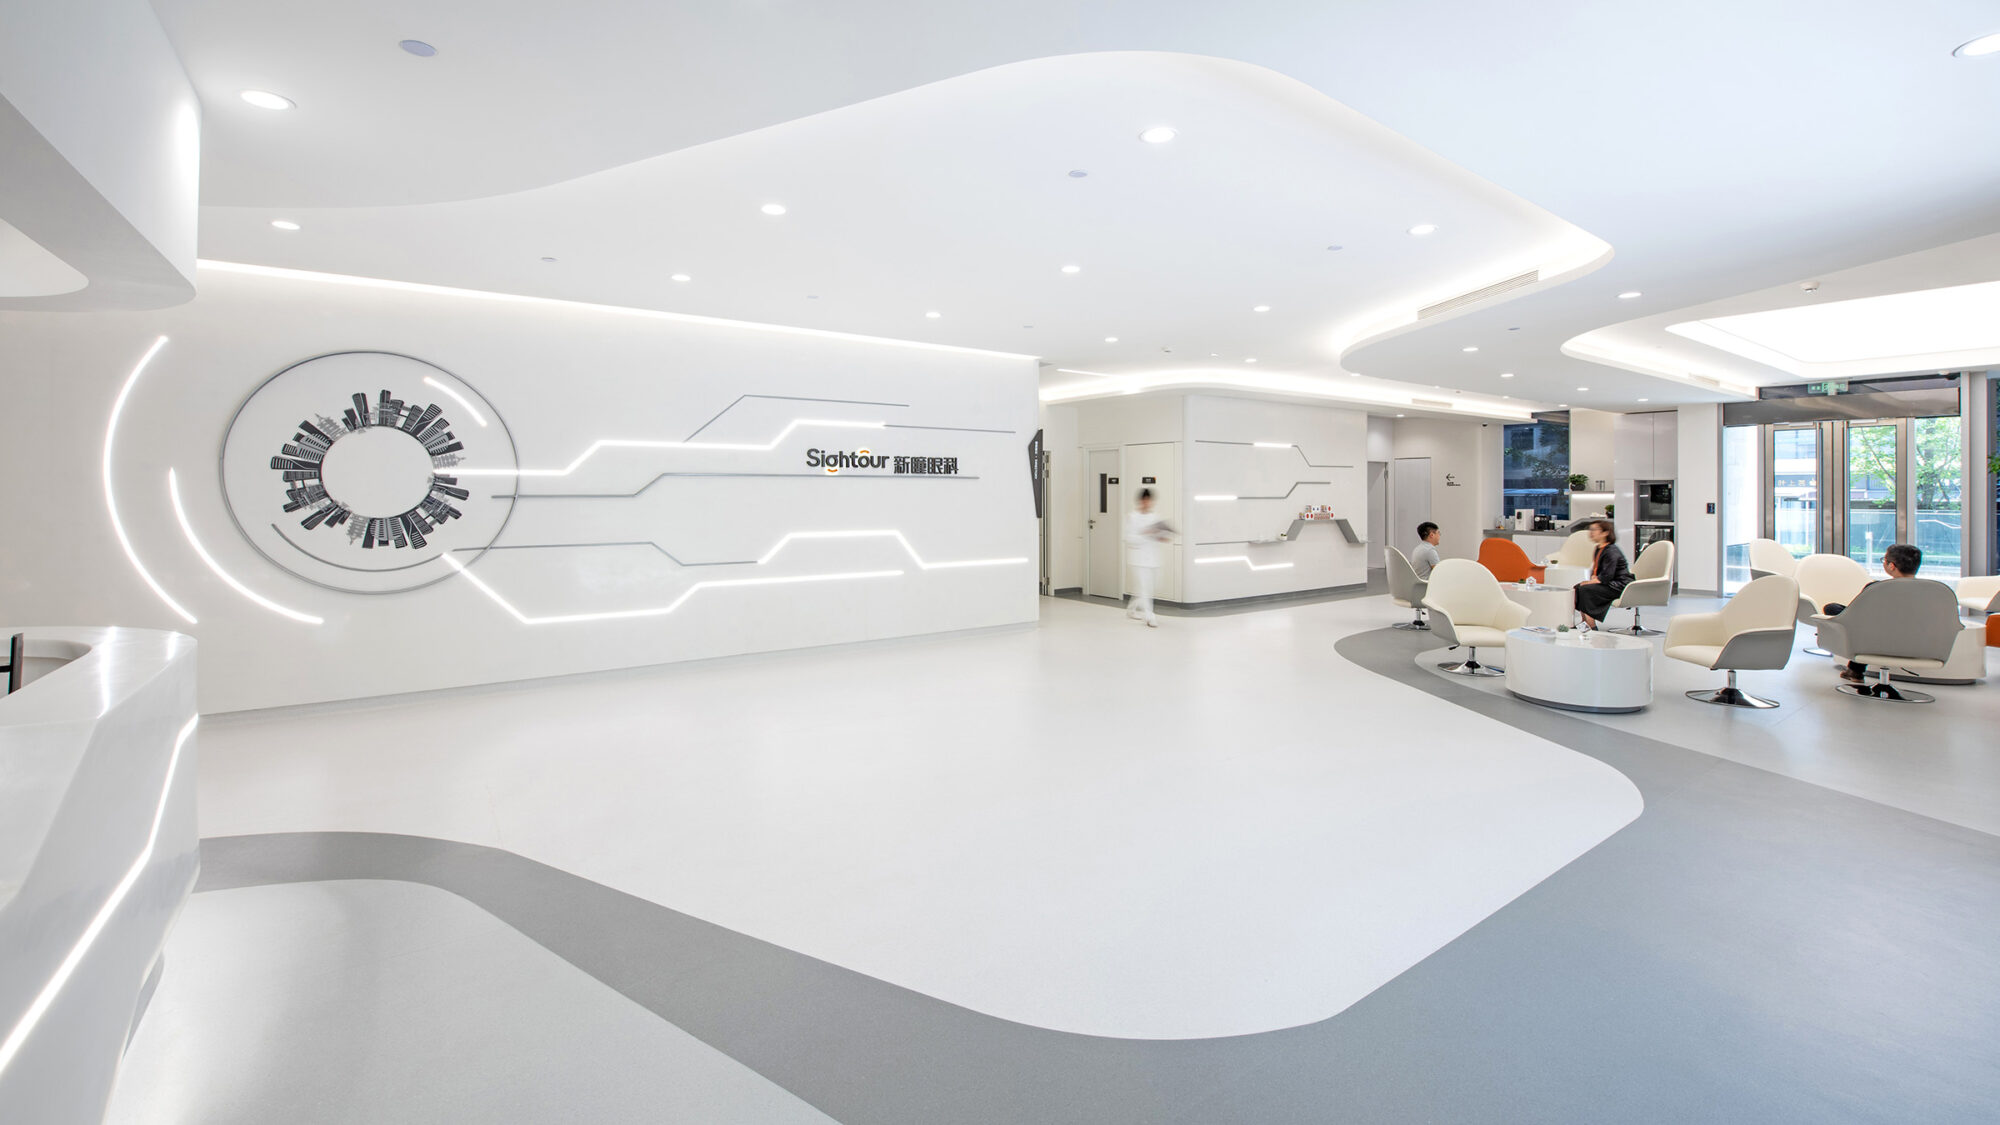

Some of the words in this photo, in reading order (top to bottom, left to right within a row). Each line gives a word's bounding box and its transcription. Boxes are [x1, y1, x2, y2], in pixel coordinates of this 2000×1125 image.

[806, 448, 889, 473] Sightour
[893, 455, 959, 475] 新瞳眼科
